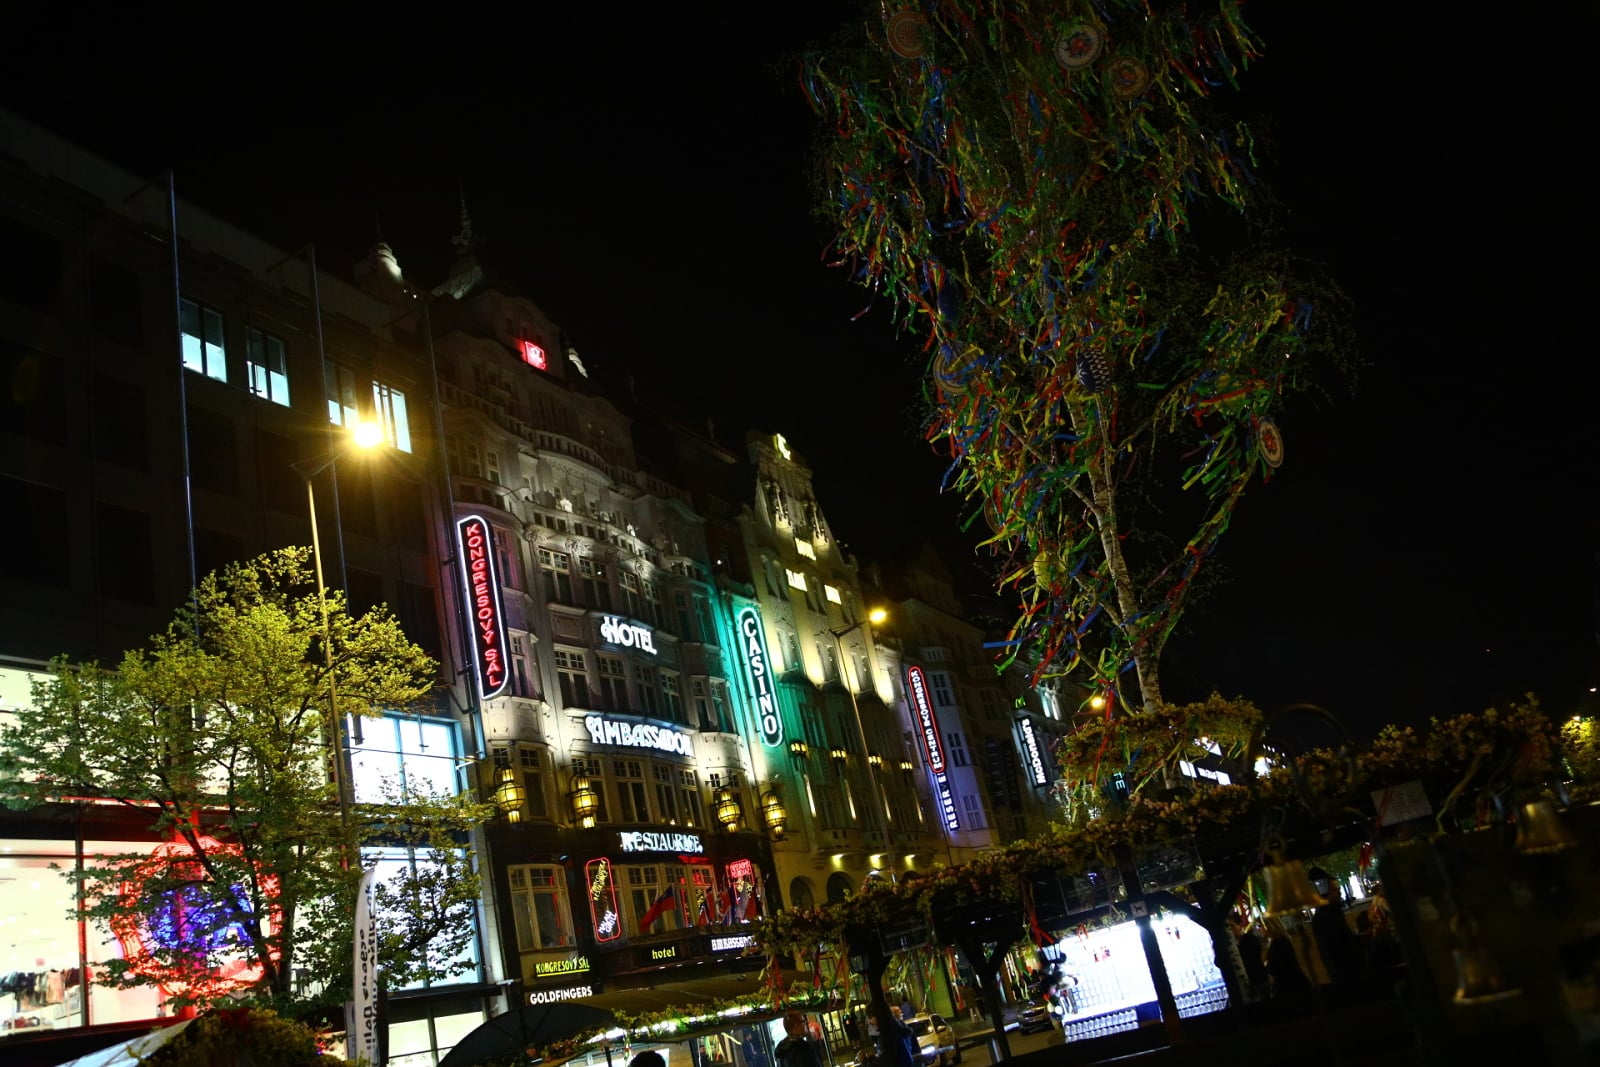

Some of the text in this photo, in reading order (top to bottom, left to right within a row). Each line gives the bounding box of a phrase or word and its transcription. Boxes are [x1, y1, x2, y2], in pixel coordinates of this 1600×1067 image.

[600, 616, 657, 655] HOTEL
[743, 617, 778, 735] CASINO
[583, 715, 696, 758] AMBASSADOR
[1021, 718, 1047, 784] McDonald's
[618, 831, 704, 854] RESTAURACE
[651, 946, 676, 960] hotel
[529, 986, 593, 1005] GOLDFINGERS
